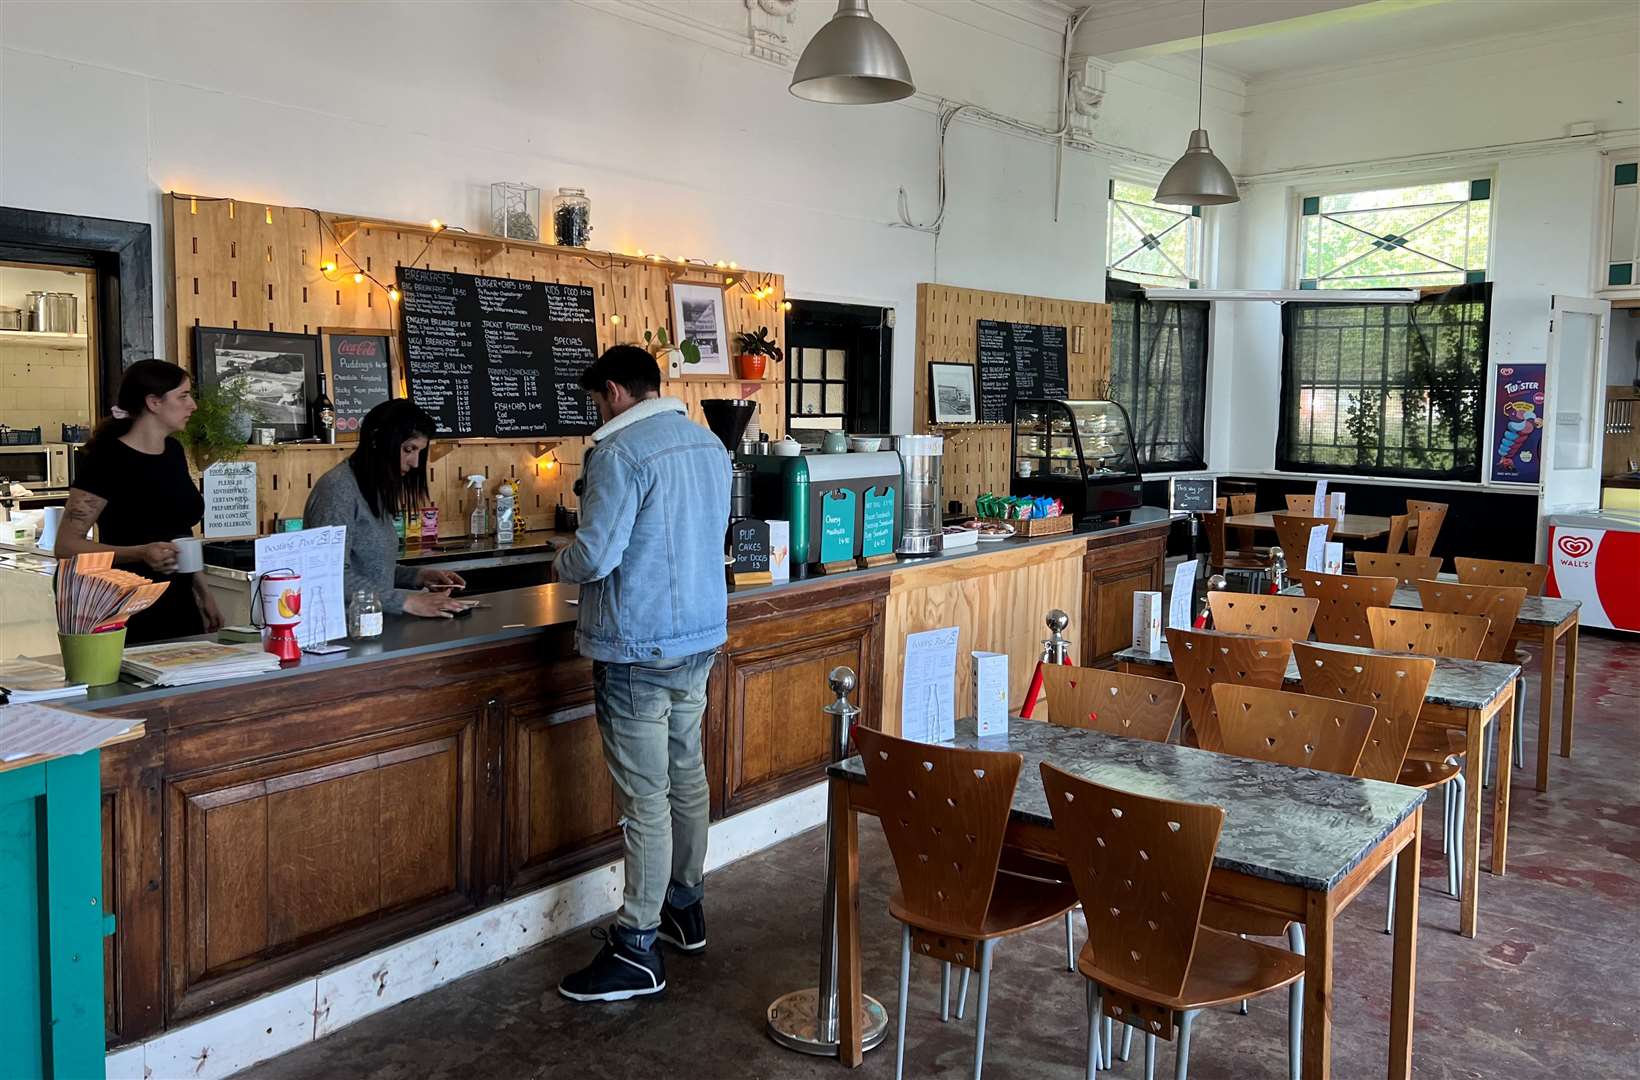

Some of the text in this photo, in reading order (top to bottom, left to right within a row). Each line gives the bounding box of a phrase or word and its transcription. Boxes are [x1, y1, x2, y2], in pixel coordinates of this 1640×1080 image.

[404, 268, 454, 285] BREAKFASTS
[545, 285, 560, 295] KIDS
[564, 286, 578, 296] FOOD
[553, 336, 583, 346] SPECIALS
[340, 358, 373, 371] Puddings
[740, 528, 755, 540] PUP
[738, 543, 761, 551] CAKES
[1560, 560, 1589, 568] WALL'S
